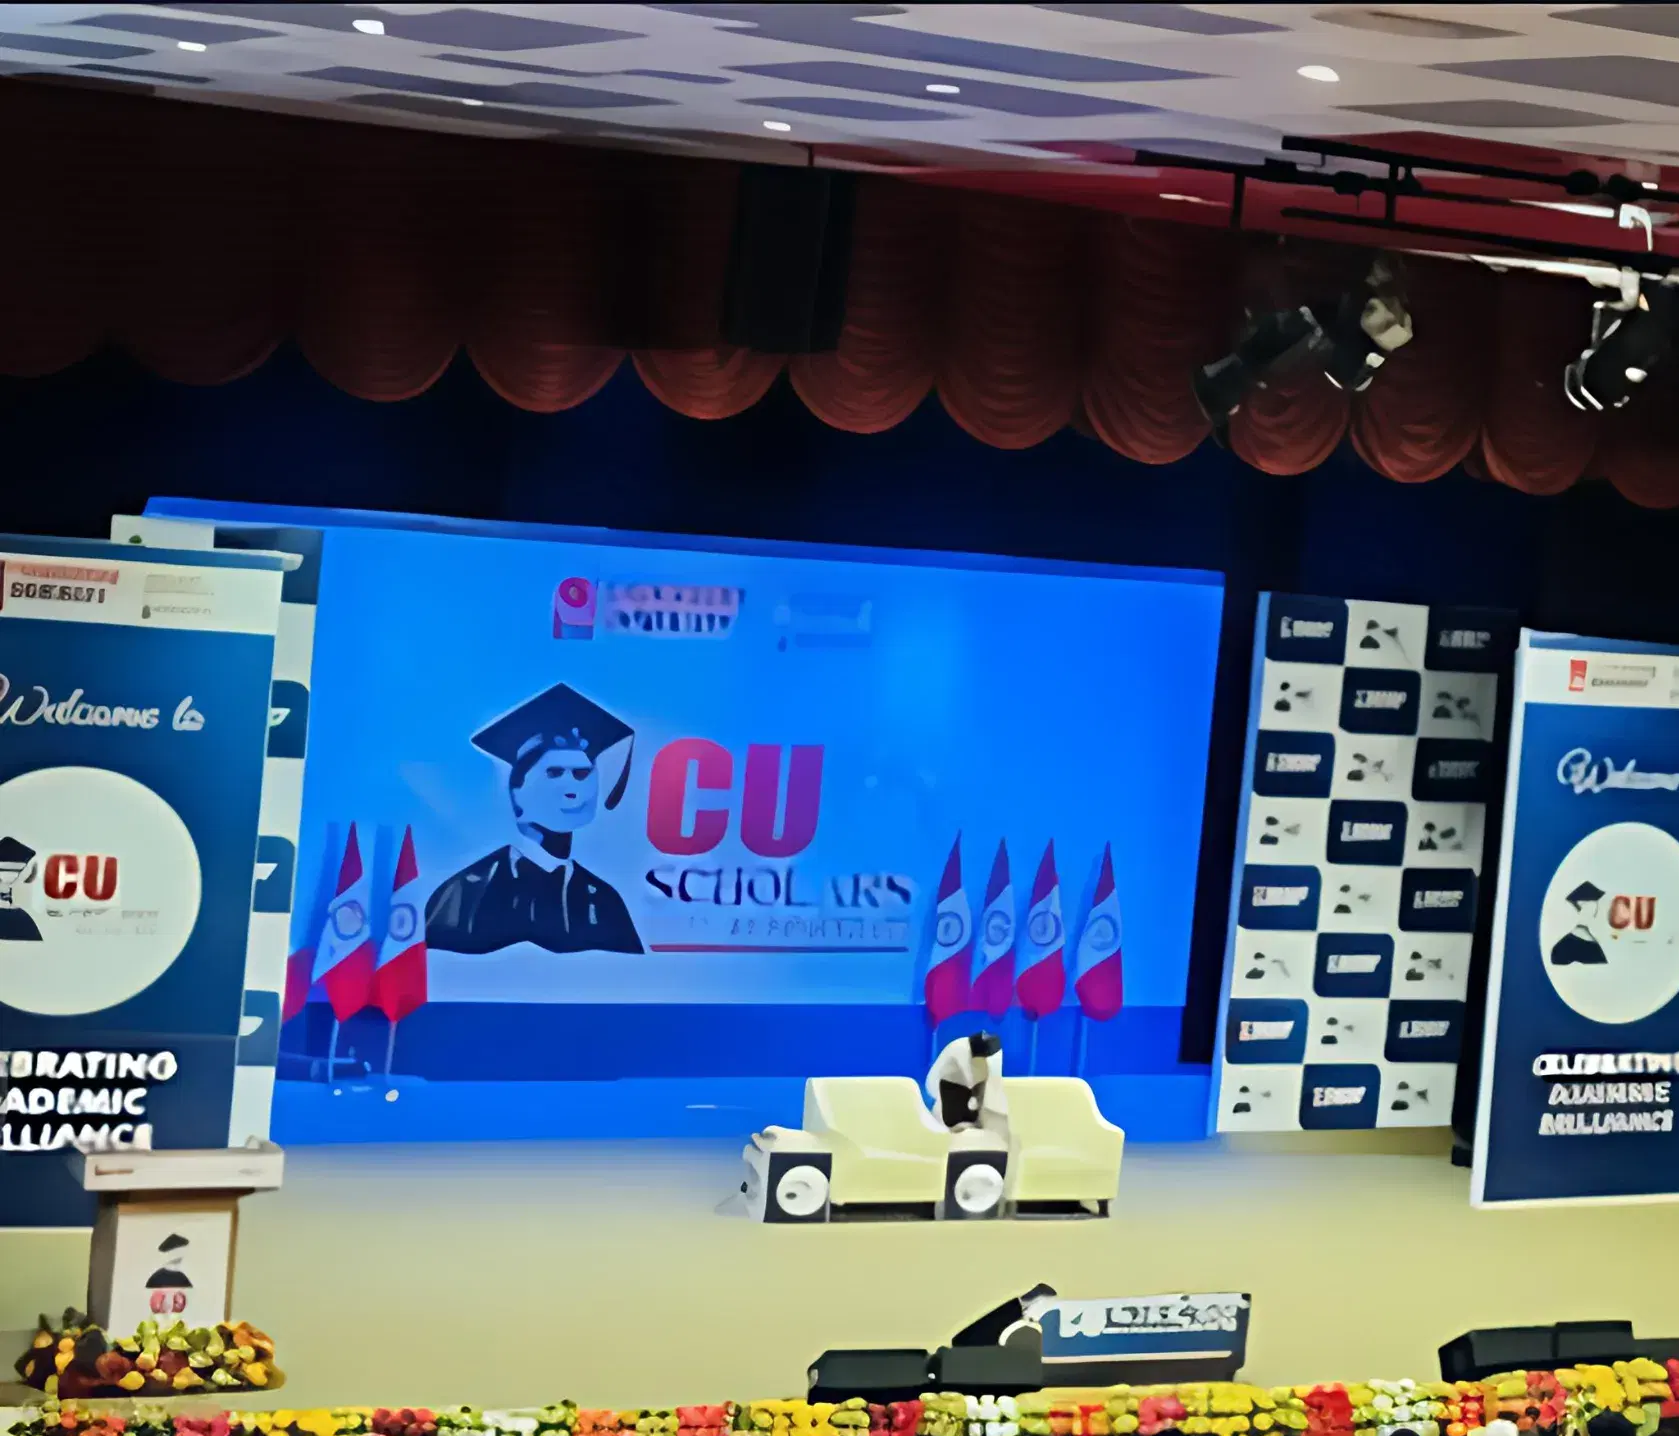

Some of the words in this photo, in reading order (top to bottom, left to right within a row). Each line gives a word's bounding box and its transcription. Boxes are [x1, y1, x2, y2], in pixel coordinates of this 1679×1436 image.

[646, 737, 826, 858] CU
[43, 853, 118, 901] CU
[645, 865, 913, 908] SCHOLARS
[1608, 895, 1656, 930] CU
[0, 1086, 148, 1116] ADEMIC
[0, 1122, 153, 1152] LLIANCE
